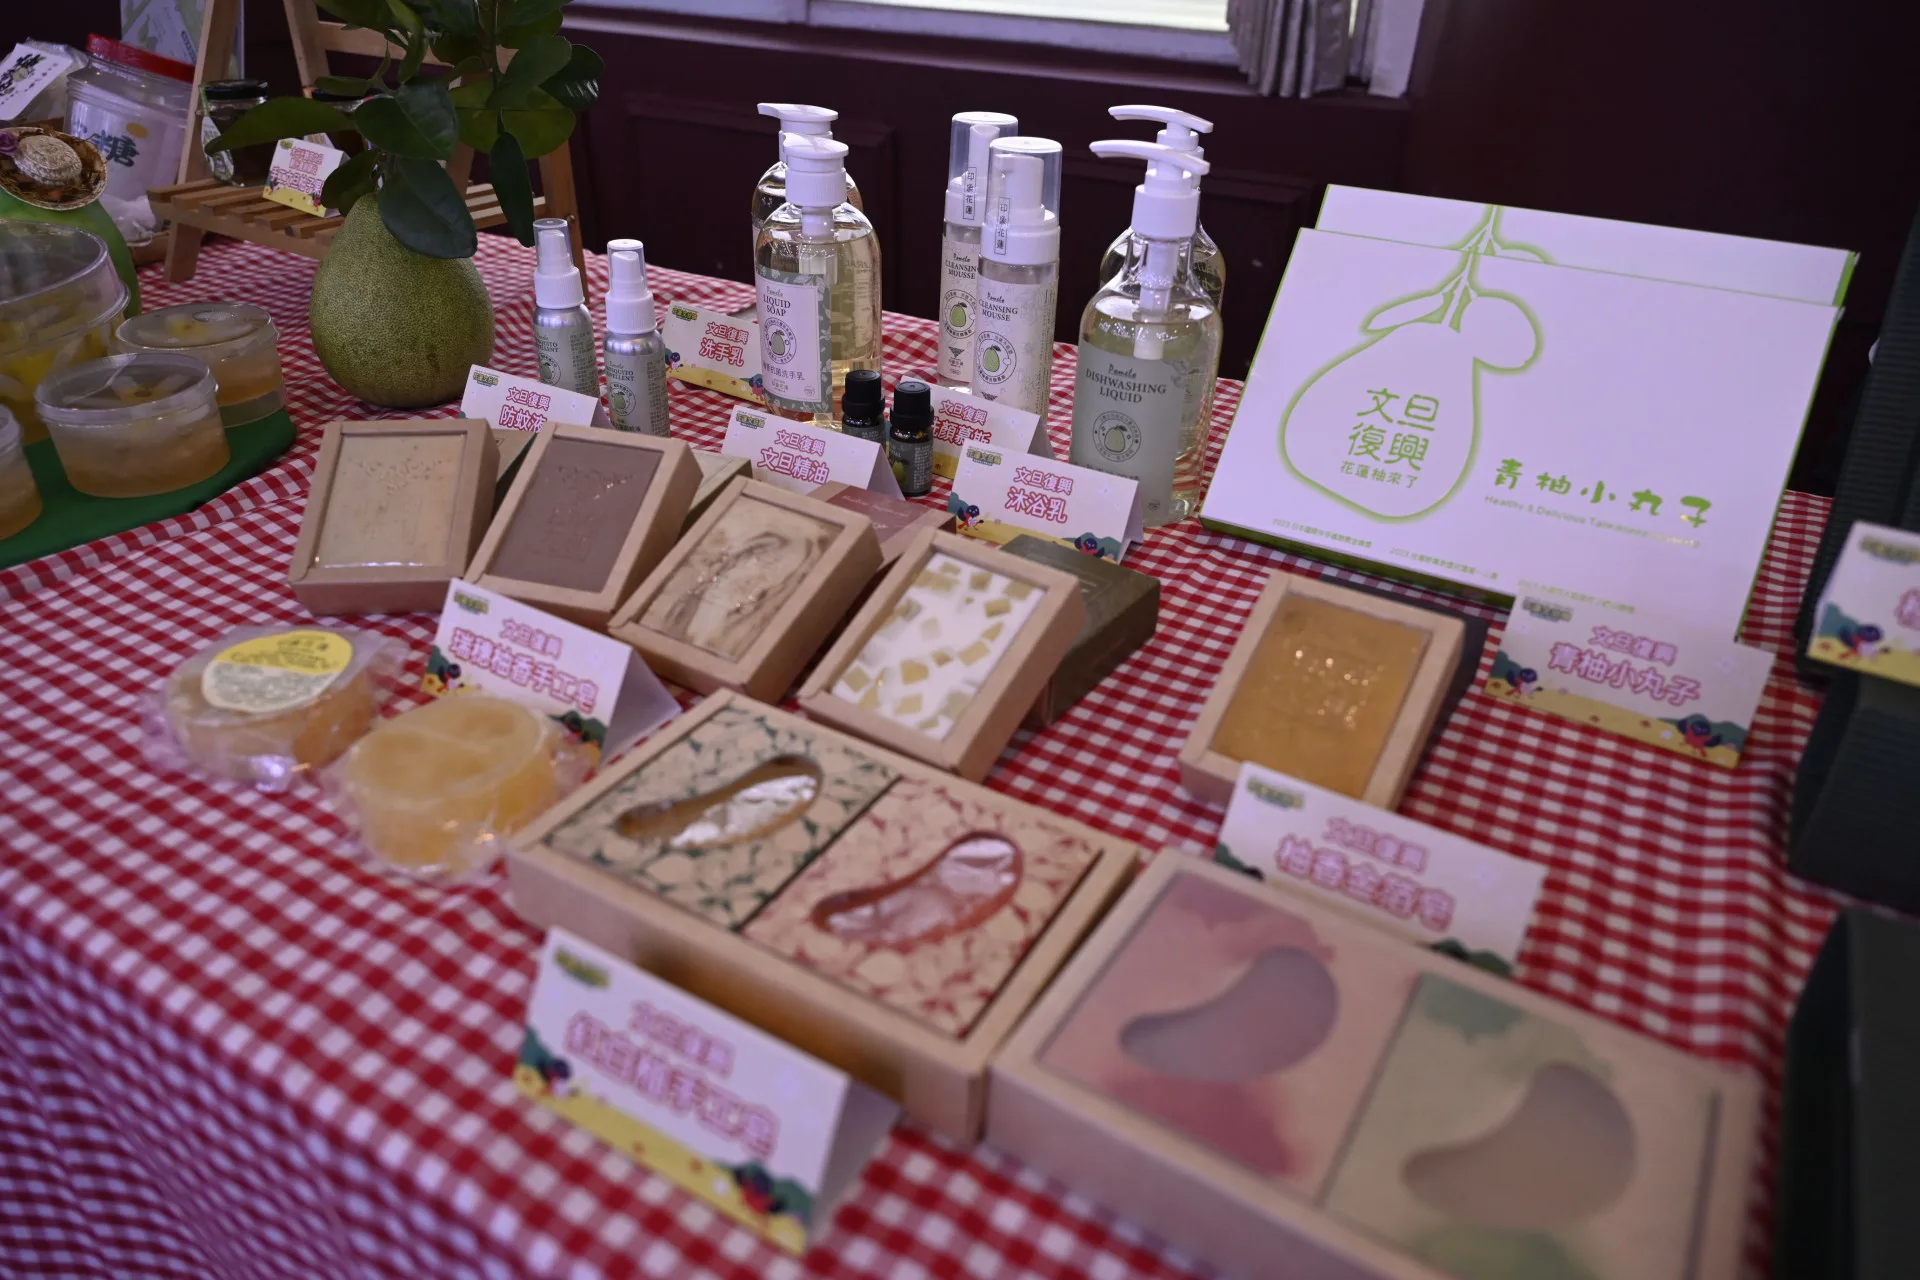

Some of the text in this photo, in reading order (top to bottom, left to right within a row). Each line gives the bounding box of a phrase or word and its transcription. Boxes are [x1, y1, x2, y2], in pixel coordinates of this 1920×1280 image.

[945, 260, 977, 272] CLEANSIN
[948, 268, 976, 280] MOUSSE
[763, 294, 791, 309] LIQUID
[766, 304, 787, 317] SOAP
[979, 298, 1018, 315] CLEANSING
[982, 308, 1011, 322] MOUSSE
[706, 321, 749, 345] 文旦復興
[699, 337, 744, 367] 洗手乳
[1085, 368, 1167, 394] DISHWASHING
[506, 386, 551, 411] 文旦復興
[1100, 386, 1143, 404] LIQUID
[499, 405, 548, 433] 防蚊液
[939, 400, 988, 425] 文旦復興
[1356, 387, 1440, 432] 文旦
[774, 430, 826, 457] 文旦復興
[1348, 422, 1431, 472] 復興
[757, 447, 830, 485] 文旦精油
[1340, 461, 1418, 488] 花蓮柚來了
[1015, 467, 1074, 495] 文旦復興
[1005, 486, 1068, 523] 沐浴乳
[1588, 625, 1678, 667] 文旦復興
[449, 627, 599, 715] 瑞穗柚香手工皂
[1548, 641, 1701, 707] 青柚小丸子
